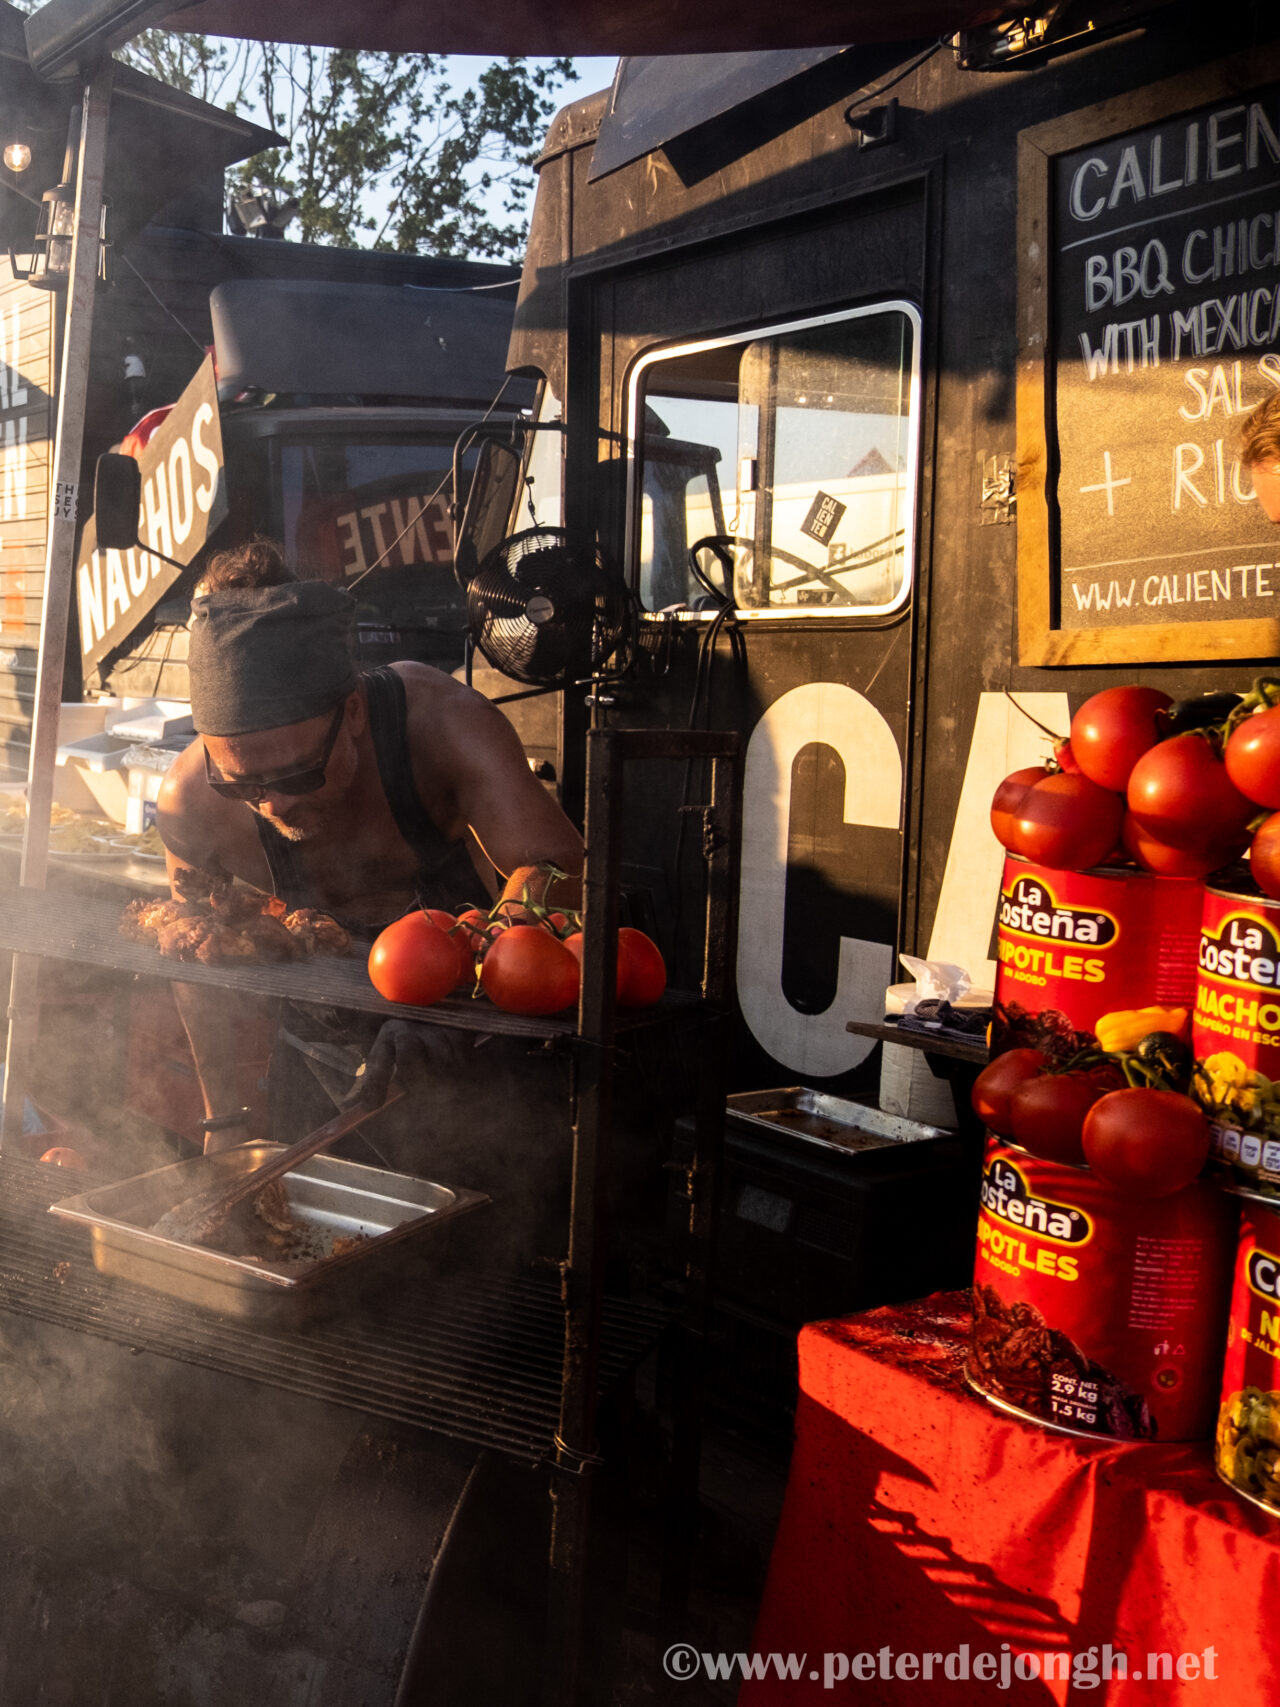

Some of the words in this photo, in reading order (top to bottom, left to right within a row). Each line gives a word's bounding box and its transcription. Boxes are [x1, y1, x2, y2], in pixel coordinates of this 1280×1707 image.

[1084, 239, 1176, 313] BBQ
[1182, 210, 1280, 284] CHIC
[1078, 313, 1161, 381] WITH
[822, 496, 837, 514] CAL
[77, 402, 220, 655] NACHOS
[1071, 561, 1280, 612] WWW.CALIENTE
[1018, 881, 1042, 906] La
[1000, 895, 1099, 943] osteña
[1230, 920, 1263, 951] La
[1199, 936, 1280, 986] Coste
[1197, 985, 1280, 1031] NACHO
[1233, 1027, 1250, 1040] EN
[995, 1163, 1016, 1192] La
[1255, 1259, 1280, 1298] C
[1051, 1380, 1075, 1395] 2.9
[1078, 1386, 1098, 1403] kg
[1052, 1401, 1073, 1416] 1.5
[1076, 1407, 1096, 1424] kg
